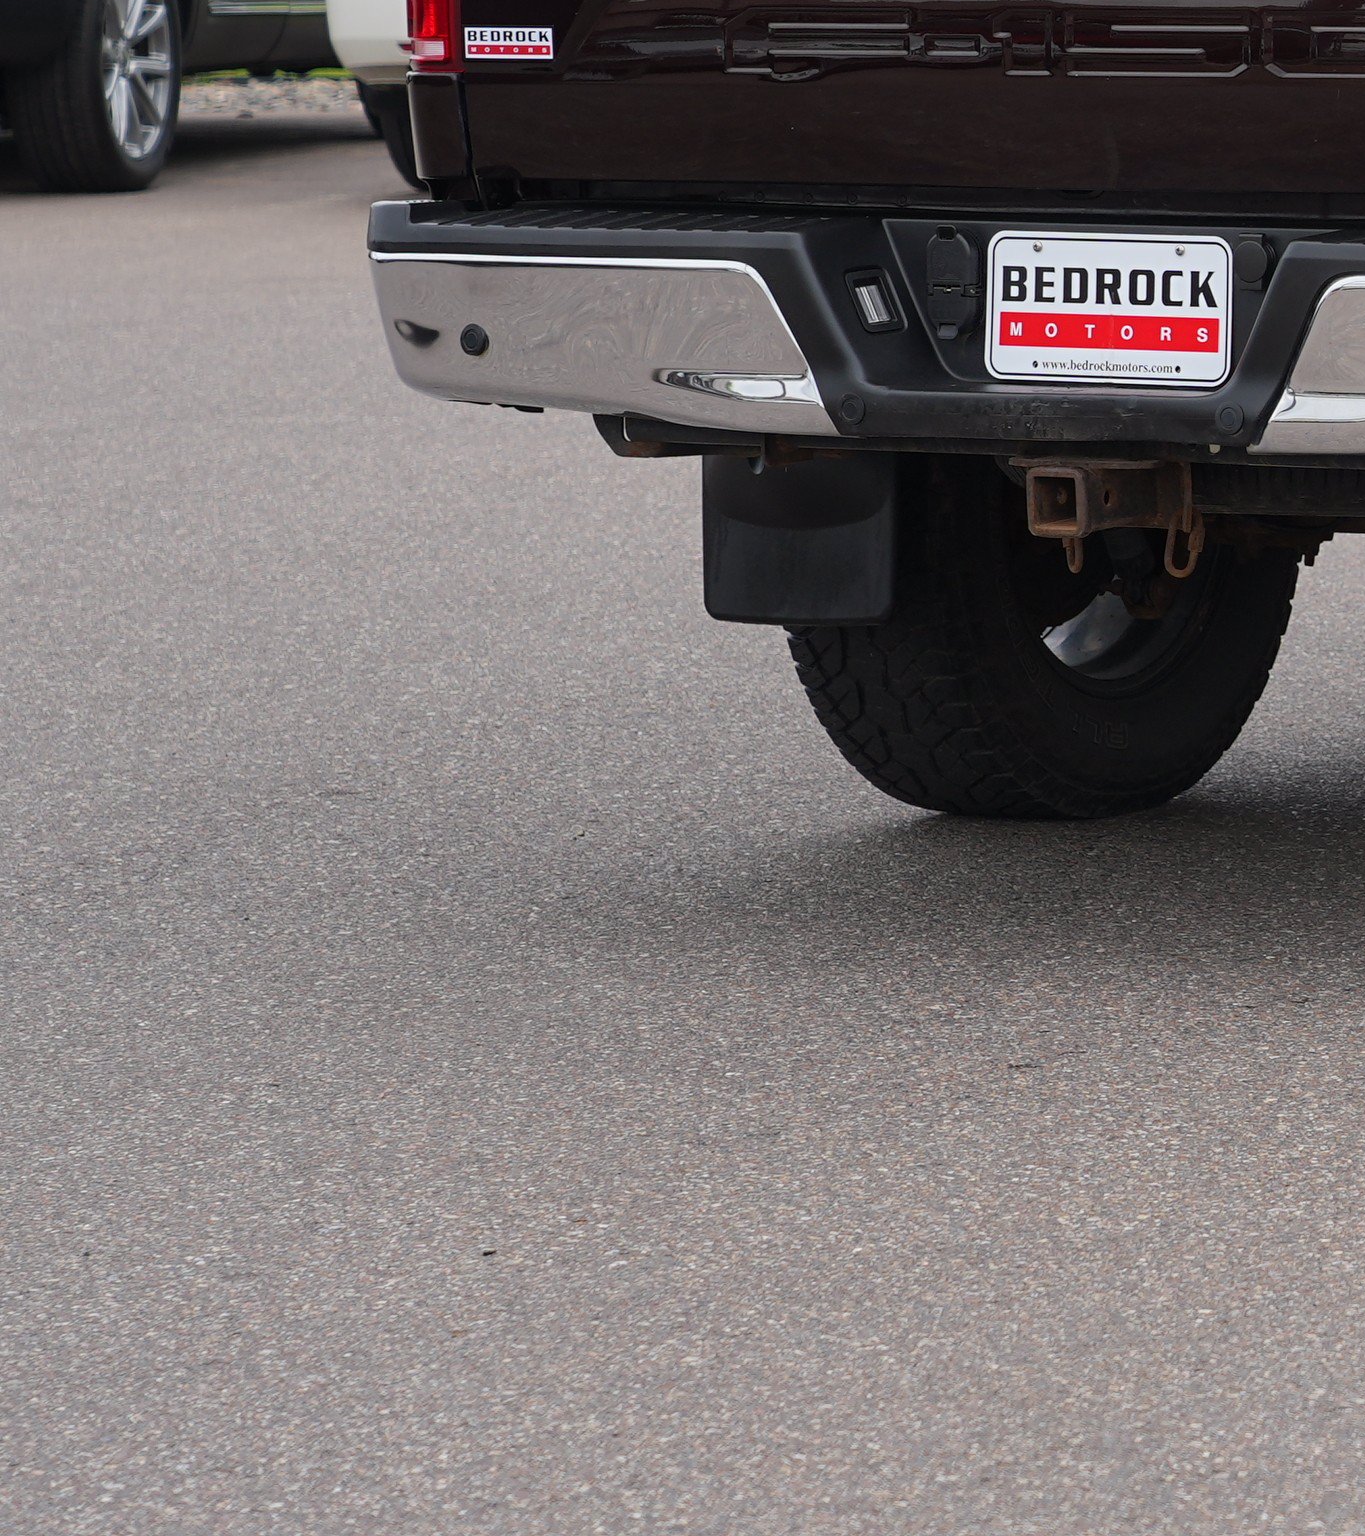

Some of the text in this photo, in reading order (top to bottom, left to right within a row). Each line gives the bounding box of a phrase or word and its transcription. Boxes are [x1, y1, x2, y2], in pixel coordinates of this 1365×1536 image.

[467, 30, 549, 42] BEDROCK
[1001, 266, 1218, 308] BEDROCK
[1010, 322, 1209, 343] MOTORS
[1042, 360, 1173, 374] www.bedrockmotors.com
